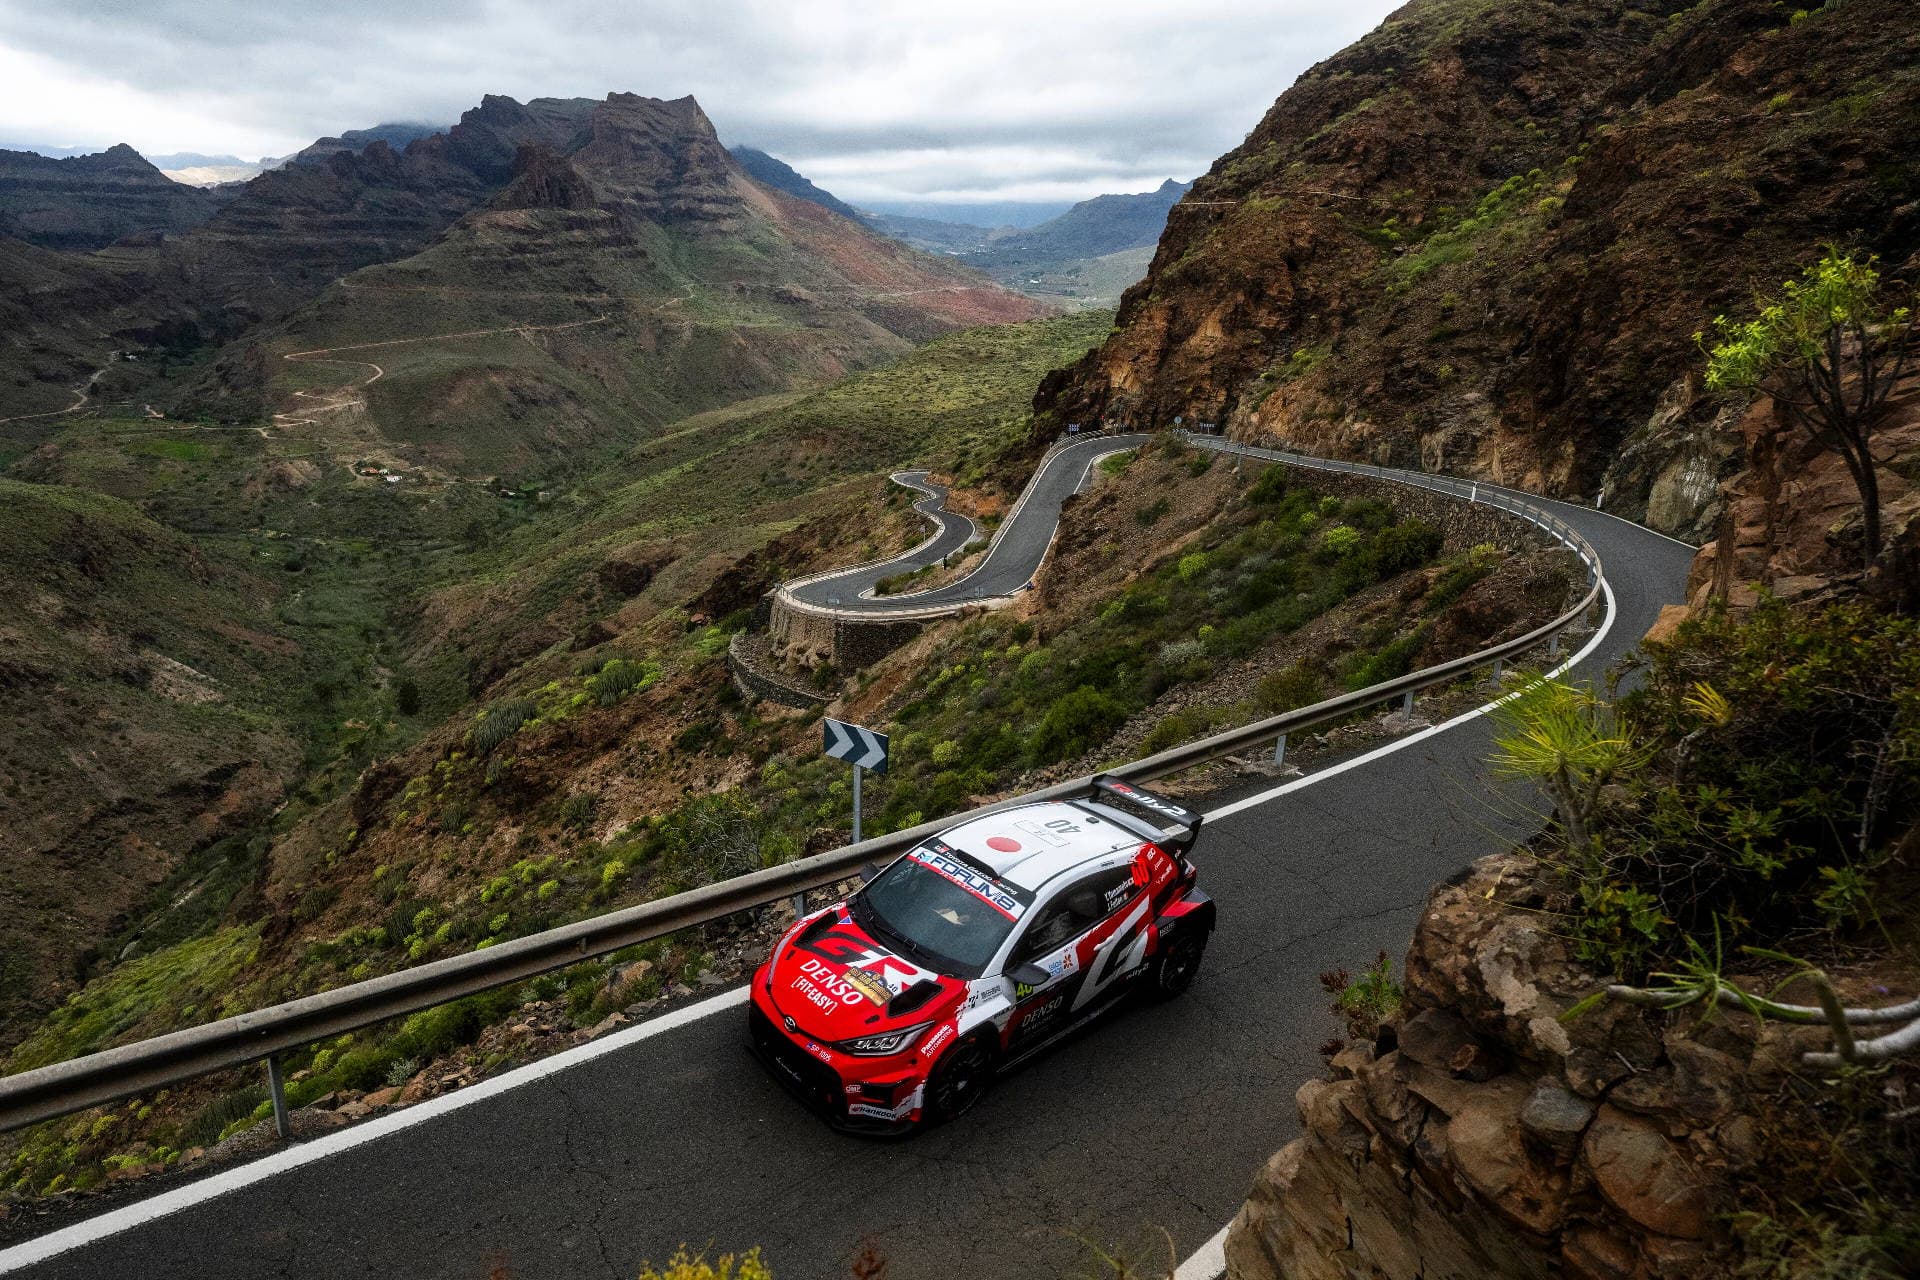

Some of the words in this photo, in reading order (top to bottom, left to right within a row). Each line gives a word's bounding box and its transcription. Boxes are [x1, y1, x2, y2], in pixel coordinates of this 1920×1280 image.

[1044, 819, 1082, 834] 40
[945, 852, 969, 868] TOYOTA
[967, 866, 993, 881] GAZOO
[800, 958, 864, 1006] DENSO
[1023, 996, 1063, 1027] DENSO
[920, 1024, 950, 1055] Panasonic
